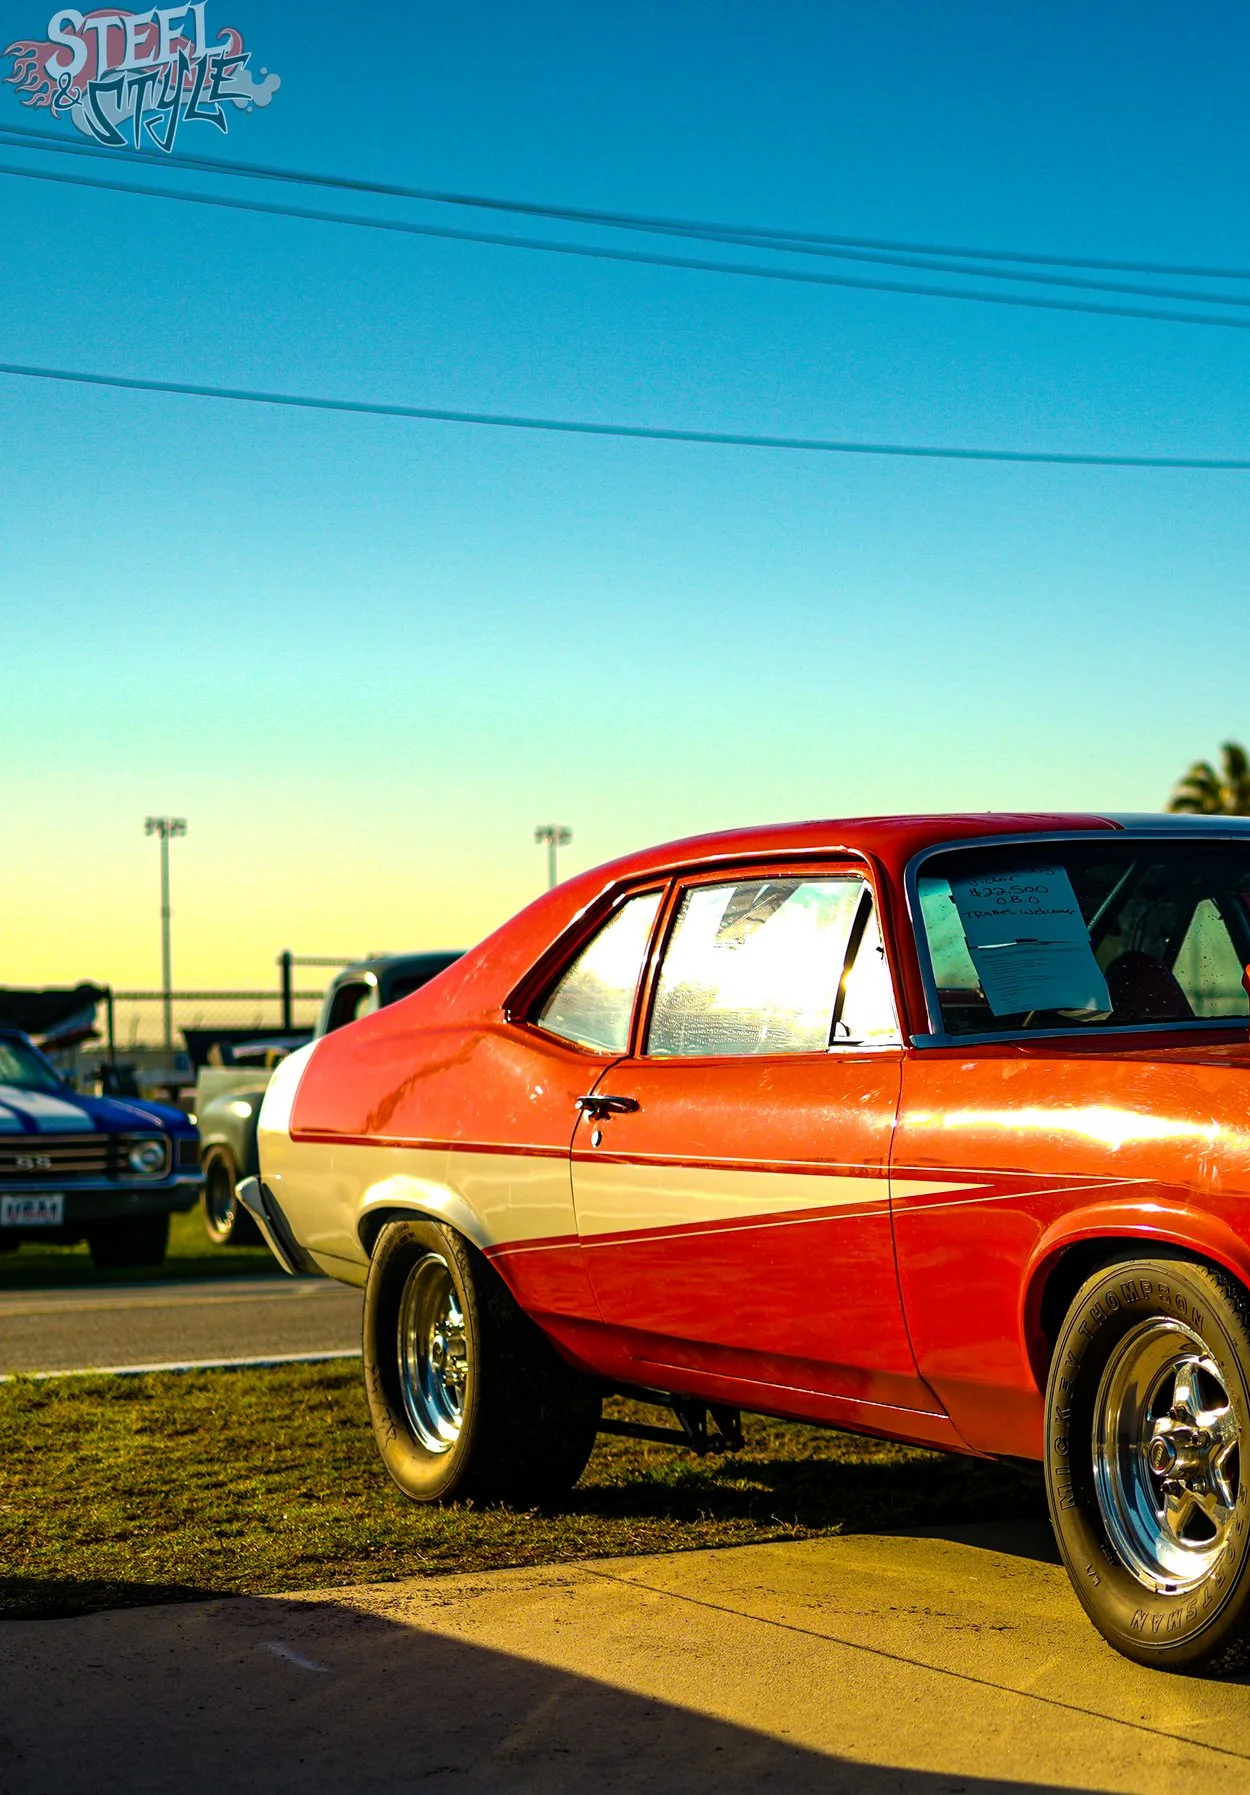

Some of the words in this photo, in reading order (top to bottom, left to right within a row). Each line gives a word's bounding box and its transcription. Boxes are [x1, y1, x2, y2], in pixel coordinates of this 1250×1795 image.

[1054, 1350, 1081, 1510] MICKEY
[1077, 1279, 1204, 1339] THOMPSON
[1130, 1482, 1248, 1633] SPORTSMAN
